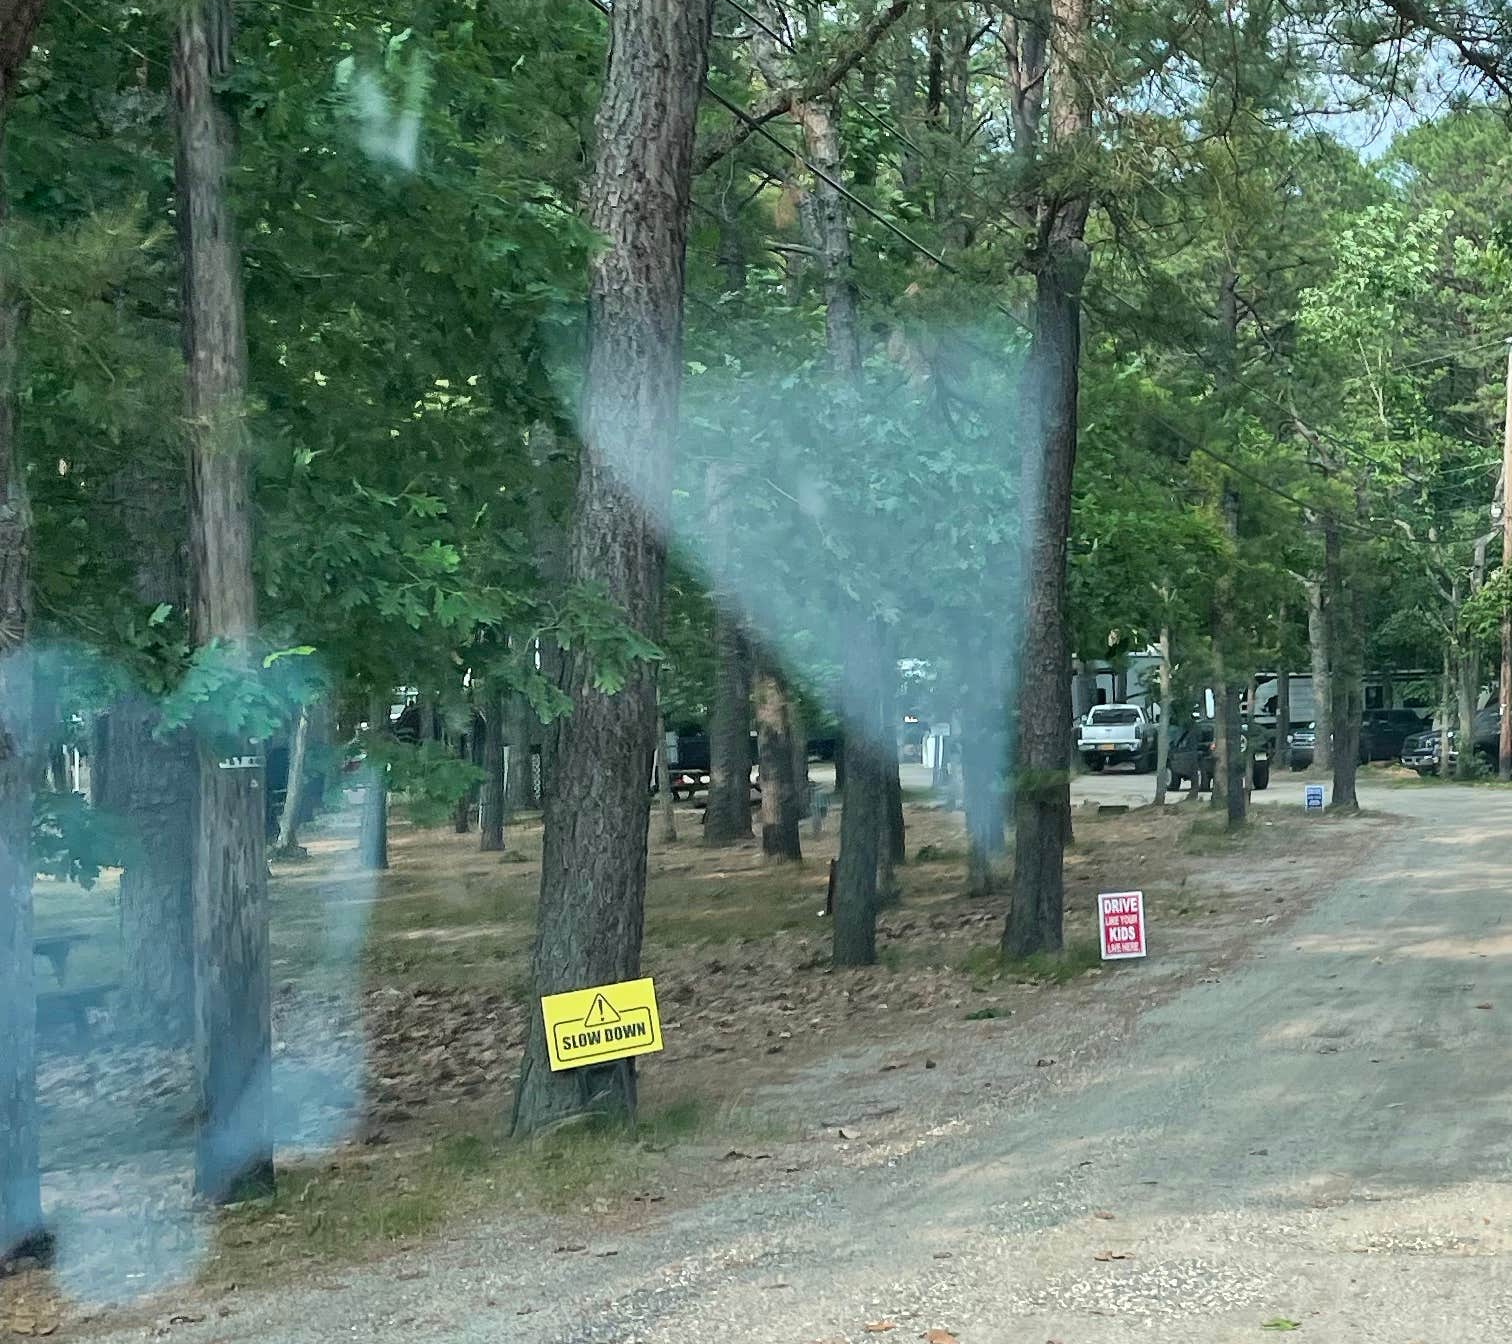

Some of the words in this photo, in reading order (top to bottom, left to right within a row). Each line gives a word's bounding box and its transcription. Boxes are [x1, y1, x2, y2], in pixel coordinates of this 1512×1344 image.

[1104, 897, 1138, 914] DRIVE
[1109, 926, 1136, 942] KIDS
[562, 1031, 601, 1050] SLOW
[604, 1022, 646, 1043] DOWN
